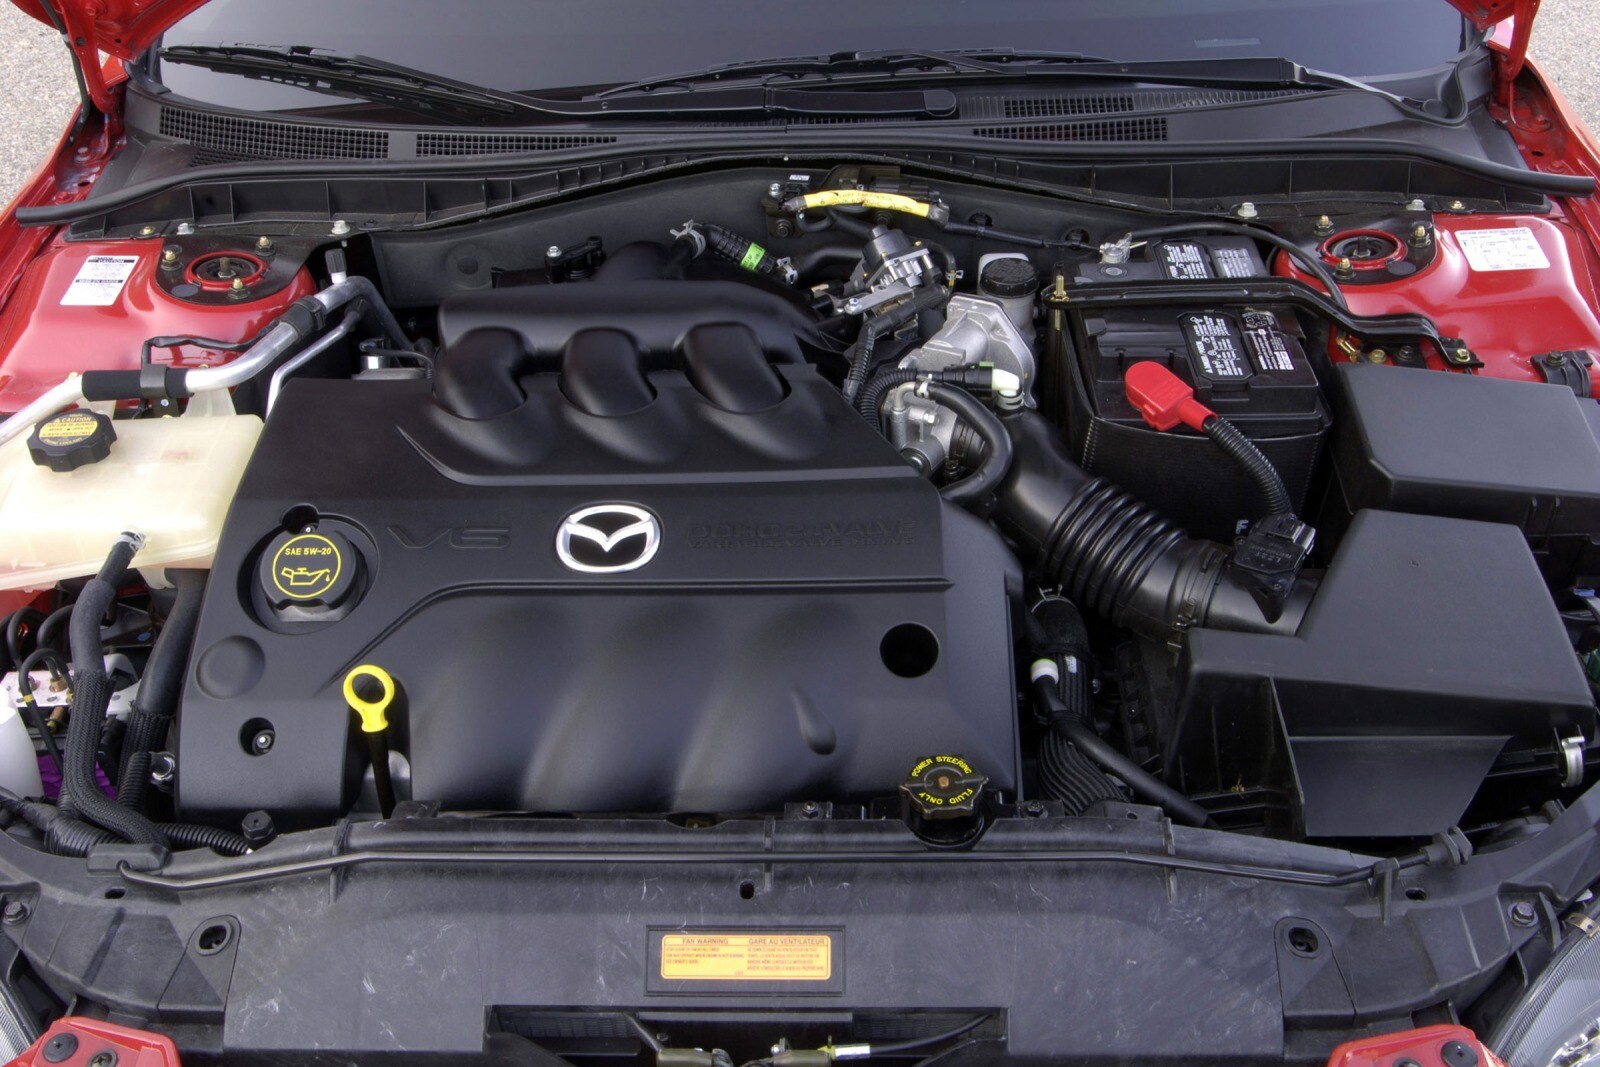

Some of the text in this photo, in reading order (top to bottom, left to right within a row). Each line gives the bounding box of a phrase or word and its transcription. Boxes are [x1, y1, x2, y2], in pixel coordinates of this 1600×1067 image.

[387, 526, 510, 549] V6
[285, 547, 332, 556] SAE 5W-20
[912, 756, 972, 777] POWER STEERING
[919, 788, 973, 804] FLUID ONLY
